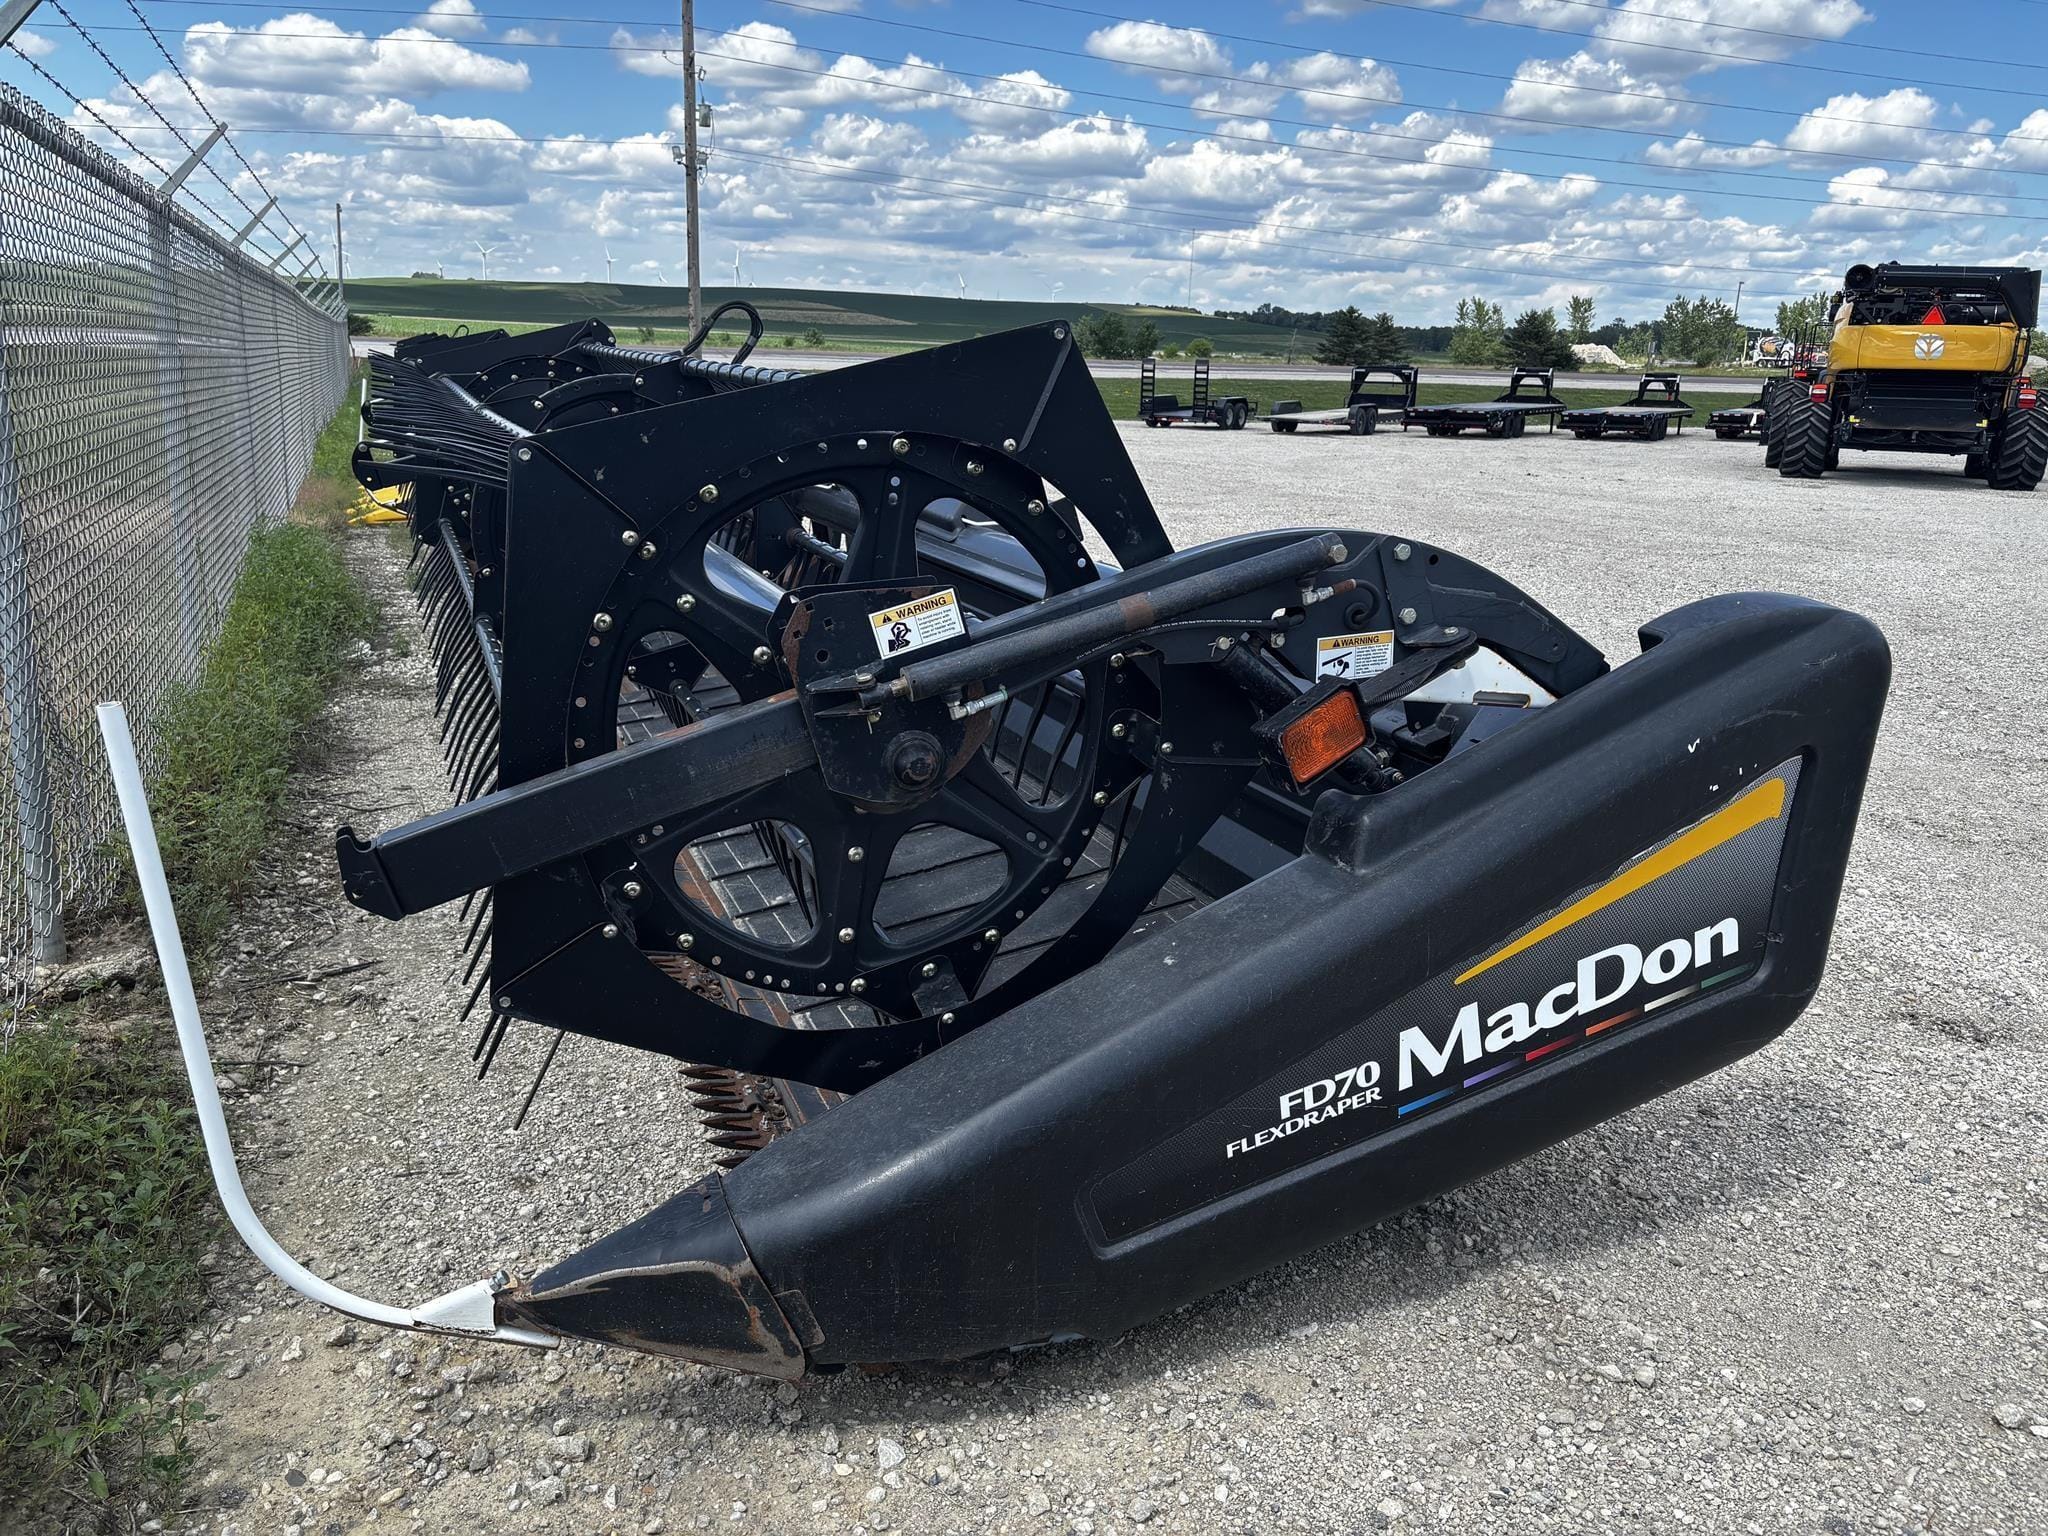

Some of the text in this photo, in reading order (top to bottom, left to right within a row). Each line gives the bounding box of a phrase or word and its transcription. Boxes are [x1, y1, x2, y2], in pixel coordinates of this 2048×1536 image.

[896, 596, 947, 619] WARNING
[1341, 635, 1380, 647] WARNING
[1398, 917, 1739, 1092] MacDon
[1279, 1061, 1381, 1120] FD70
[1226, 1087, 1383, 1159] FLEXDRAPER
